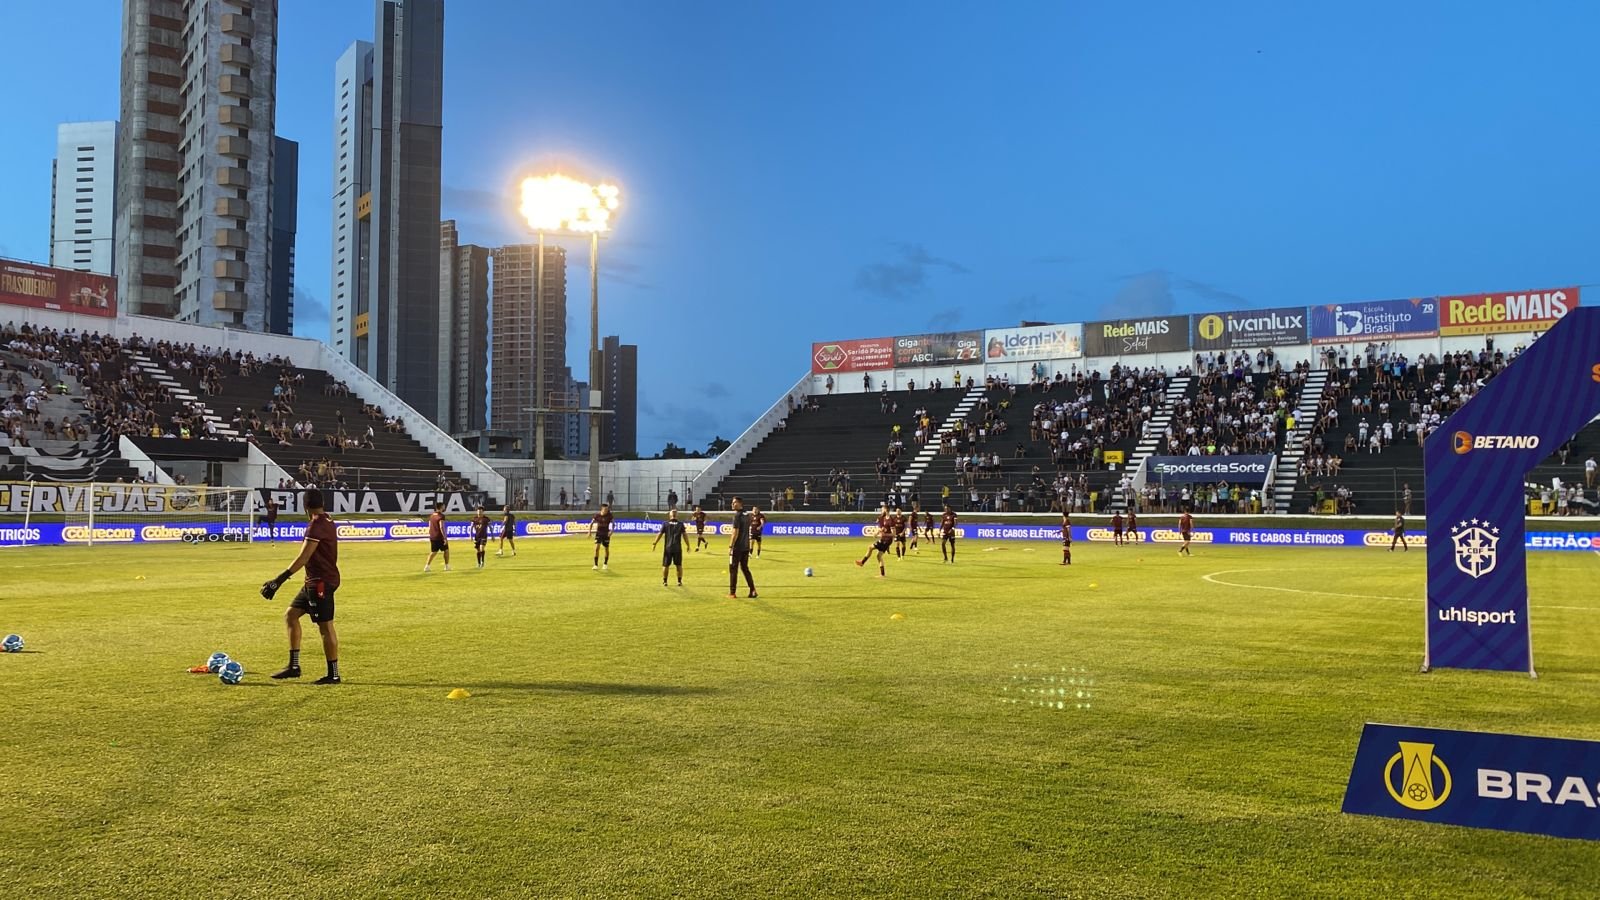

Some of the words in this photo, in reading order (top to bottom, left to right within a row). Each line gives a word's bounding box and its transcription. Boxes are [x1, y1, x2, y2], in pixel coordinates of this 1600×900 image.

[1449, 290, 1568, 325] RedeMAIS
[1227, 312, 1303, 332] ivanlux
[1363, 313, 1412, 324] Instituto
[1103, 319, 1170, 338] RedeMAIS
[1364, 322, 1395, 334] Brasil
[957, 340, 977, 348] Giga
[1122, 336, 1152, 352] Select
[911, 353, 934, 362] ABC!
[1473, 435, 1540, 449] BETANO
[1153, 462, 1211, 475] Esportes
[1211, 462, 1229, 473] da
[1229, 462, 1266, 474] Sorte
[333, 491, 382, 512] NA
[280, 524, 306, 538] ELÉTR
[392, 525, 430, 538] cobreco
[447, 525, 460, 534] FIOS
[461, 525, 466, 534] E
[772, 525, 786, 534] FIOS
[787, 526, 793, 534] E
[793, 526, 814, 535] CABOS
[815, 524, 850, 536] ELÉTRICOS
[978, 528, 995, 538] FIOS
[996, 529, 1002, 538] E
[1002, 528, 1028, 538] CABOS
[1029, 527, 1064, 539] ELÉTRIC
[1230, 532, 1250, 542] FIOS
[1252, 533, 1258, 542] E
[1259, 533, 1293, 543] CABOS
[1293, 531, 1345, 544] ELÉTRICOS
[1439, 606, 1516, 626] uhlsport
[1477, 768, 1600, 808] BRA
